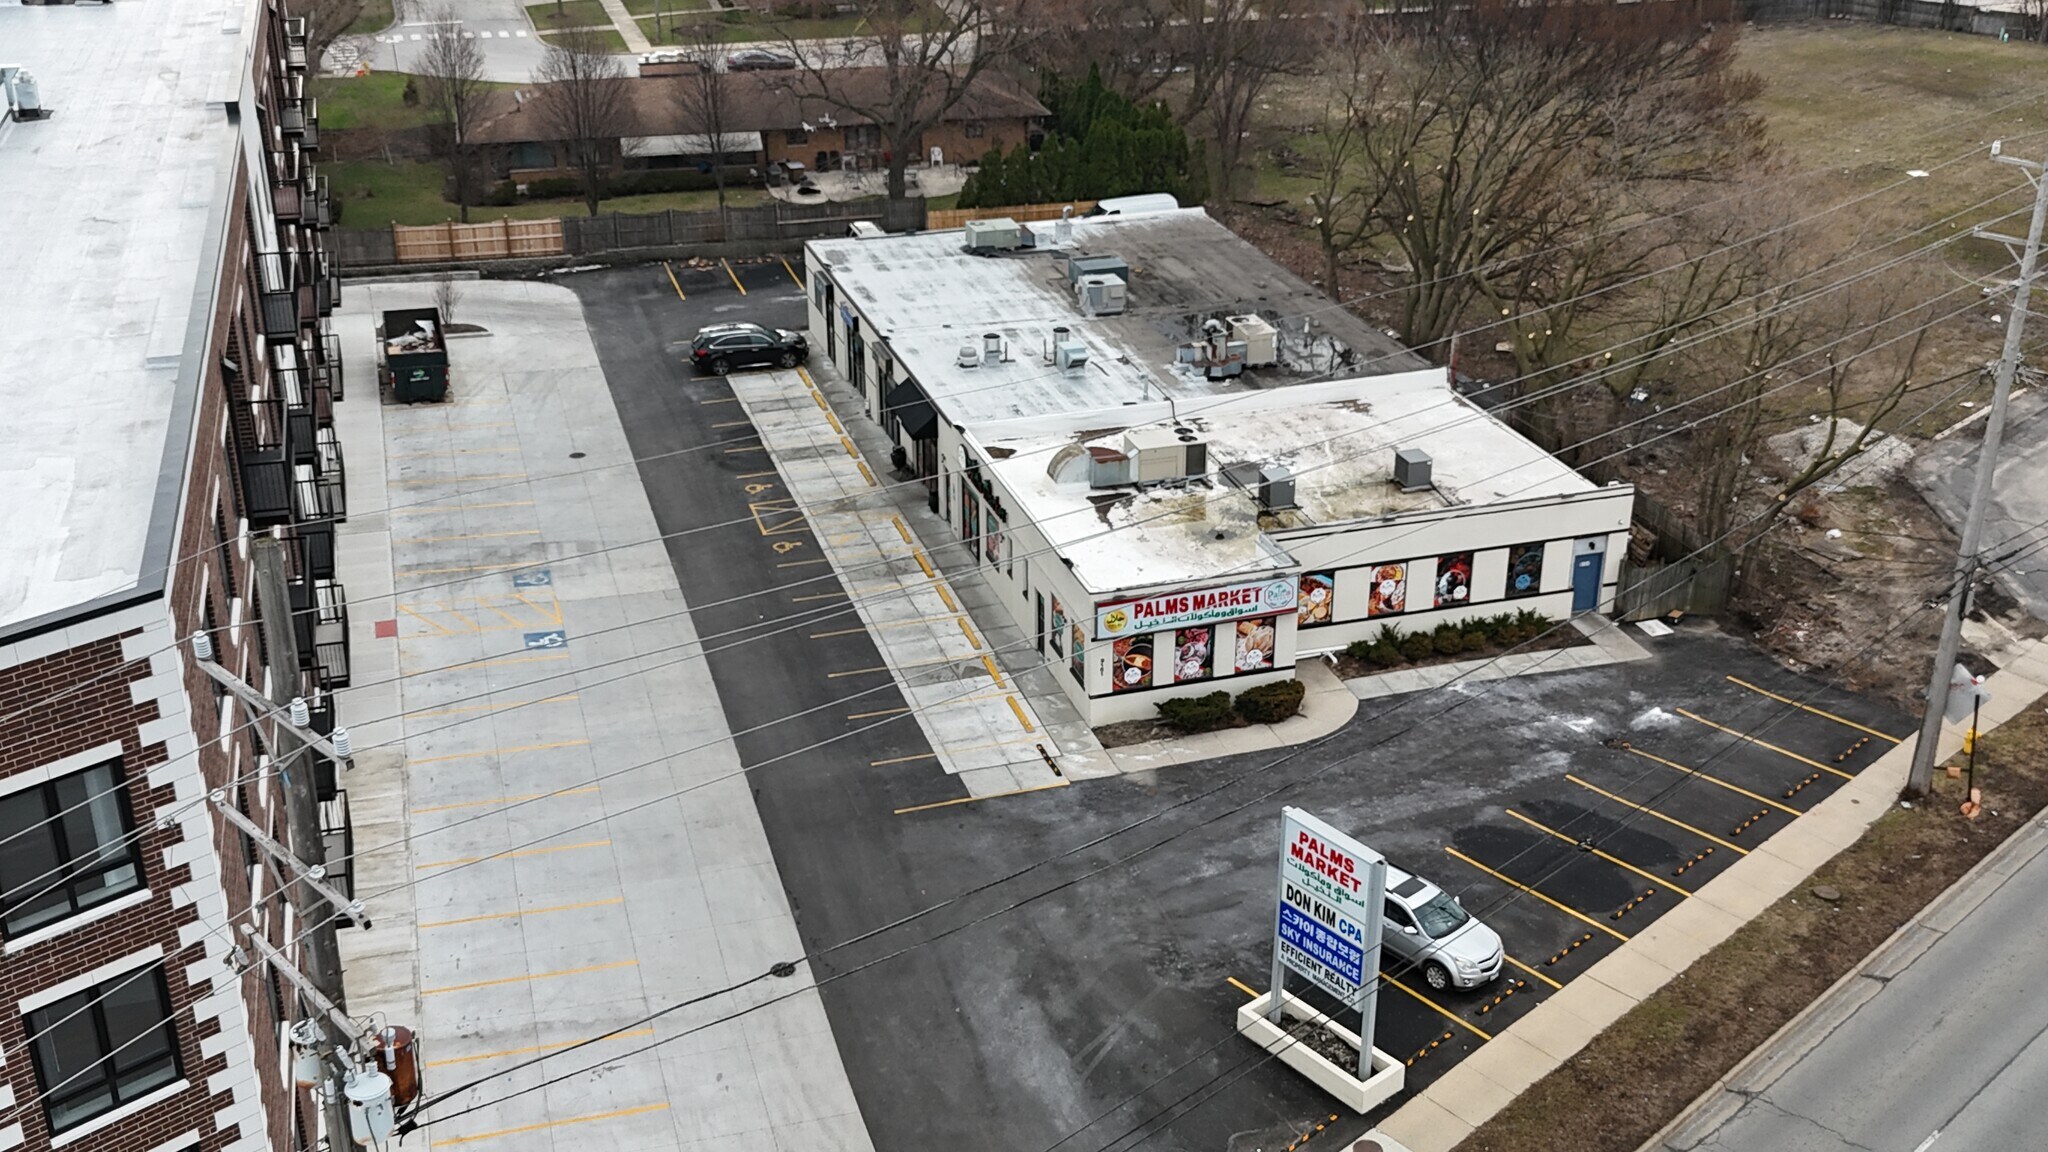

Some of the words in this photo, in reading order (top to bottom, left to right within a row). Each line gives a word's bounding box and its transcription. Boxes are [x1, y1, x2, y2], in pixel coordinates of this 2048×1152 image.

[1134, 597, 1189, 619] PALMS
[1192, 587, 1262, 611] MARKET
[1291, 842, 1361, 893] MARKET
[1299, 831, 1354, 873] PALMS
[1286, 883, 1311, 912] DON
[1314, 900, 1336, 928] KIM
[1338, 918, 1362, 944] CPA
[1281, 923, 1301, 943] SKY
[1303, 936, 1360, 981] INSURANCE
[1281, 941, 1323, 974] EFFICIENT
[1324, 968, 1358, 996] REALTY
